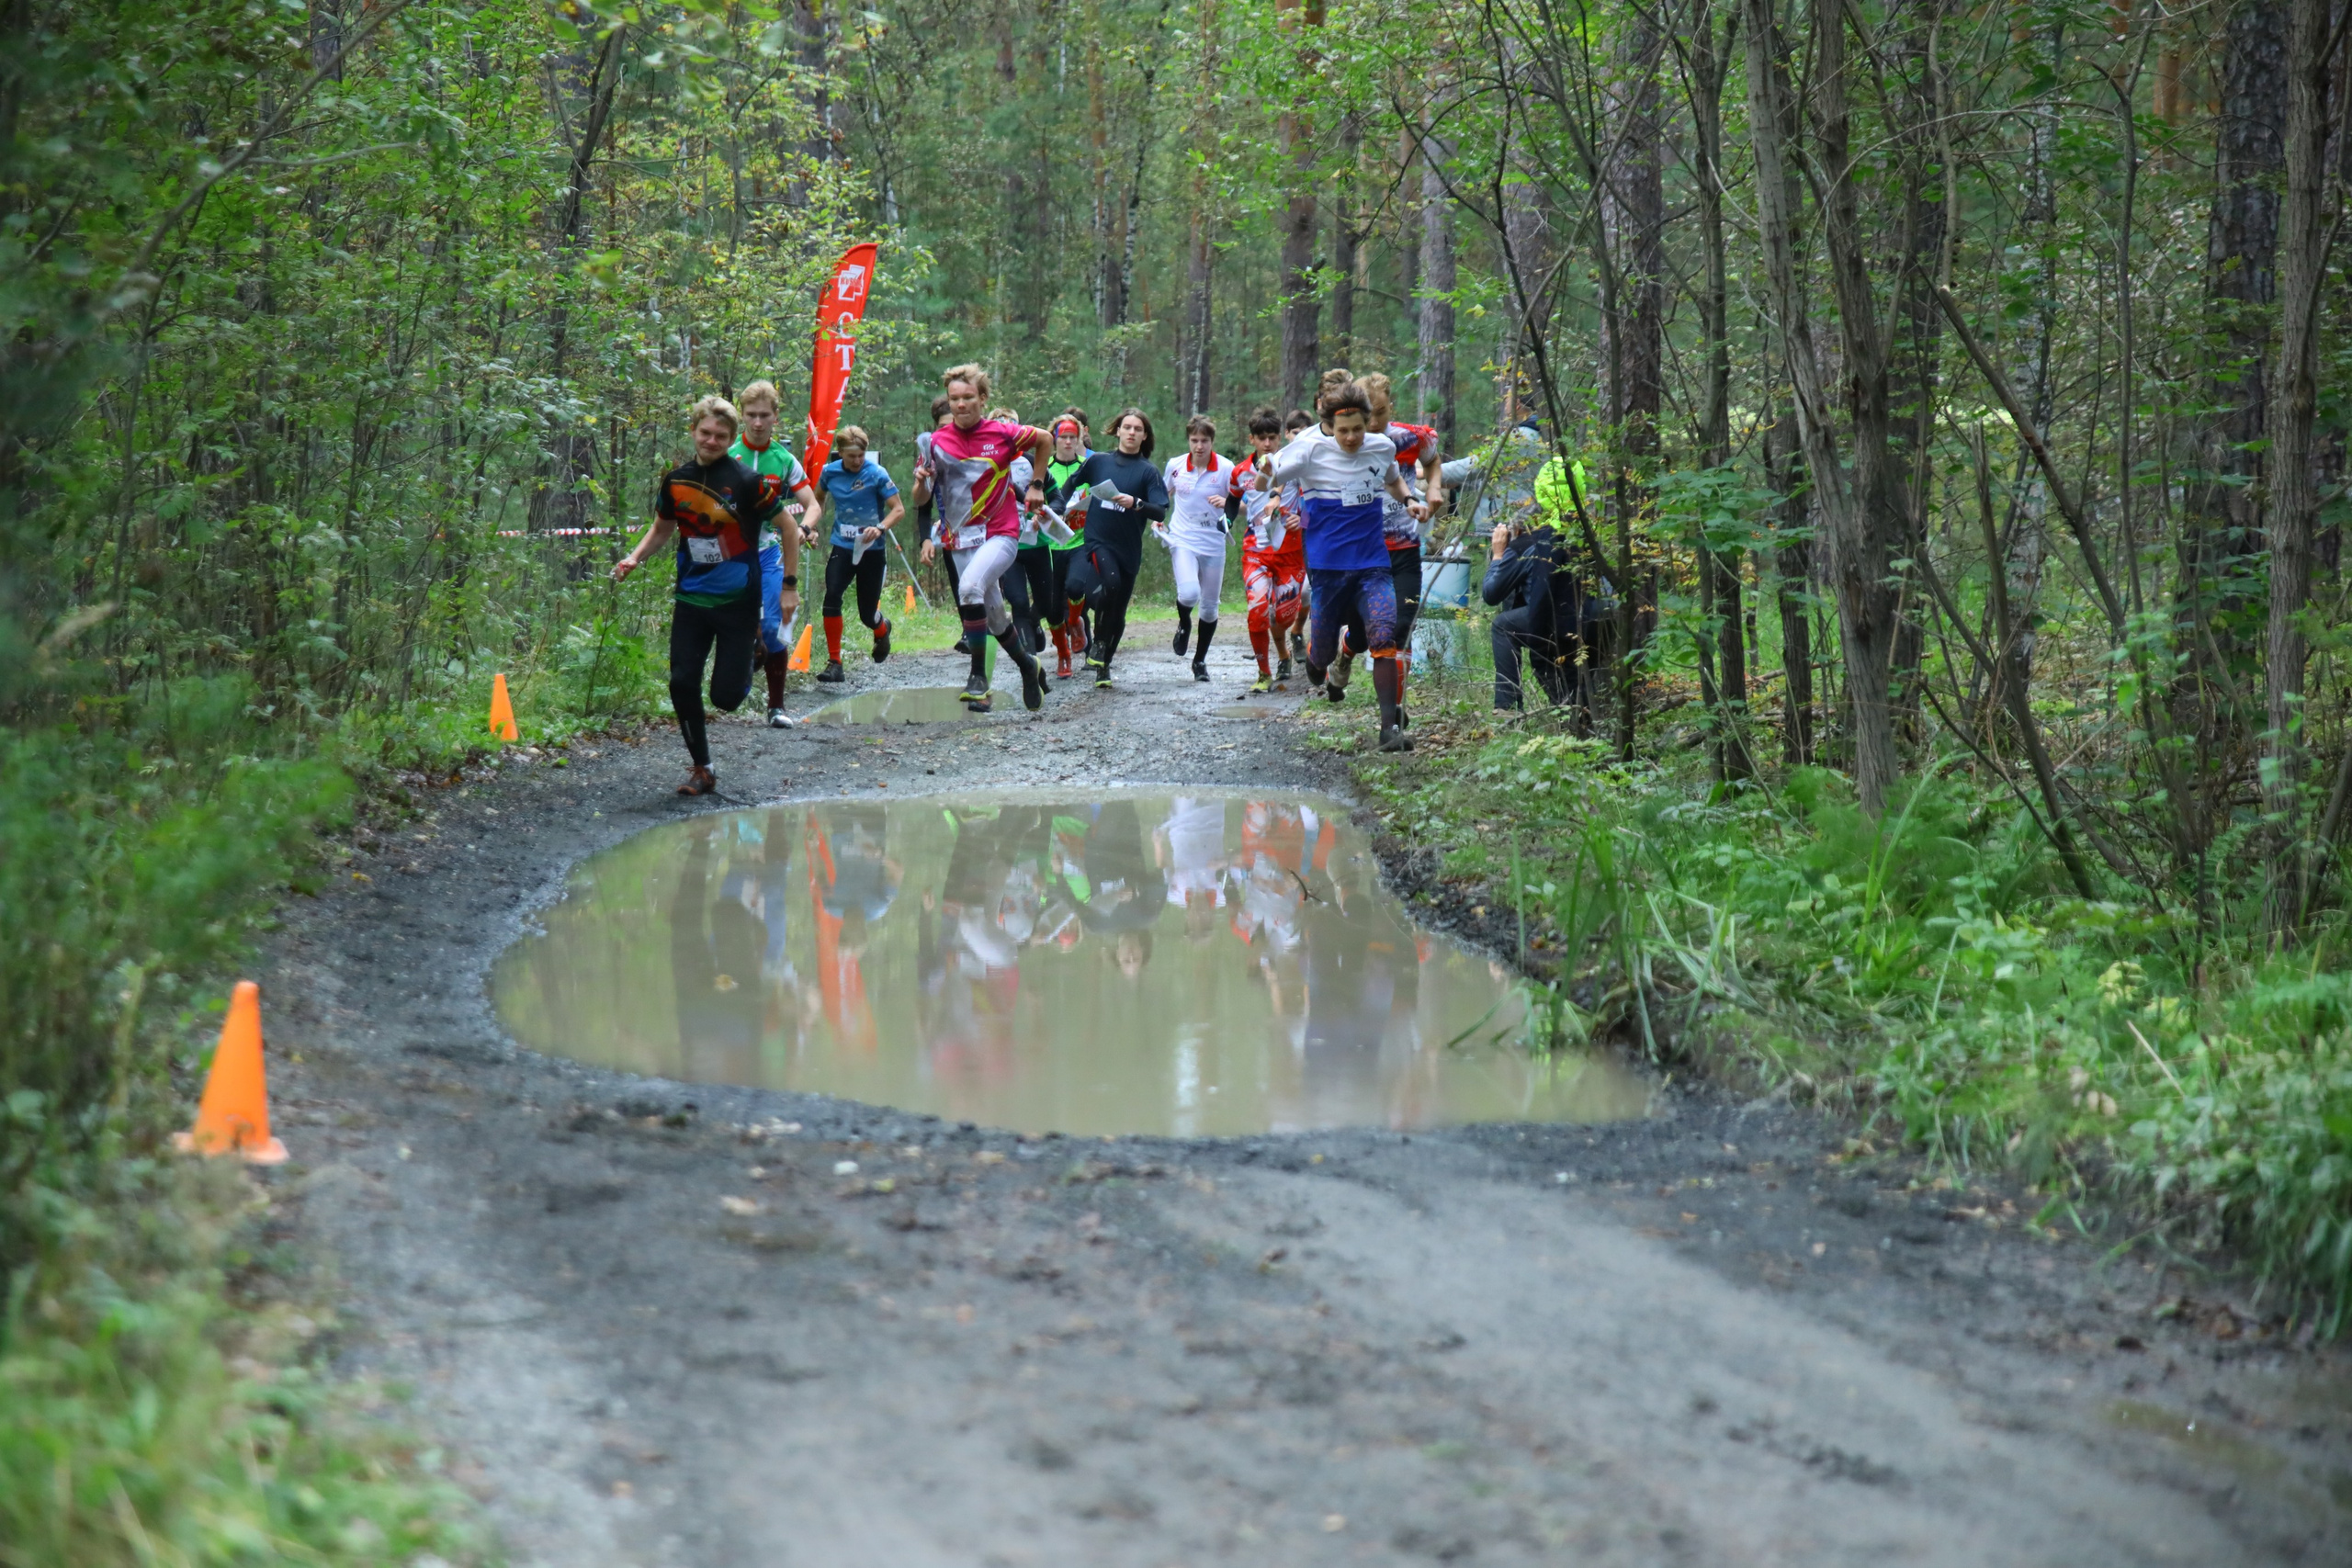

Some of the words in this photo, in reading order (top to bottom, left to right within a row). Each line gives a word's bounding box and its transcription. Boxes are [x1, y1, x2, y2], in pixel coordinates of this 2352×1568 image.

[834, 311, 856, 414] СТА
[1356, 493, 1372, 503] 103
[704, 553, 721, 563] 102
